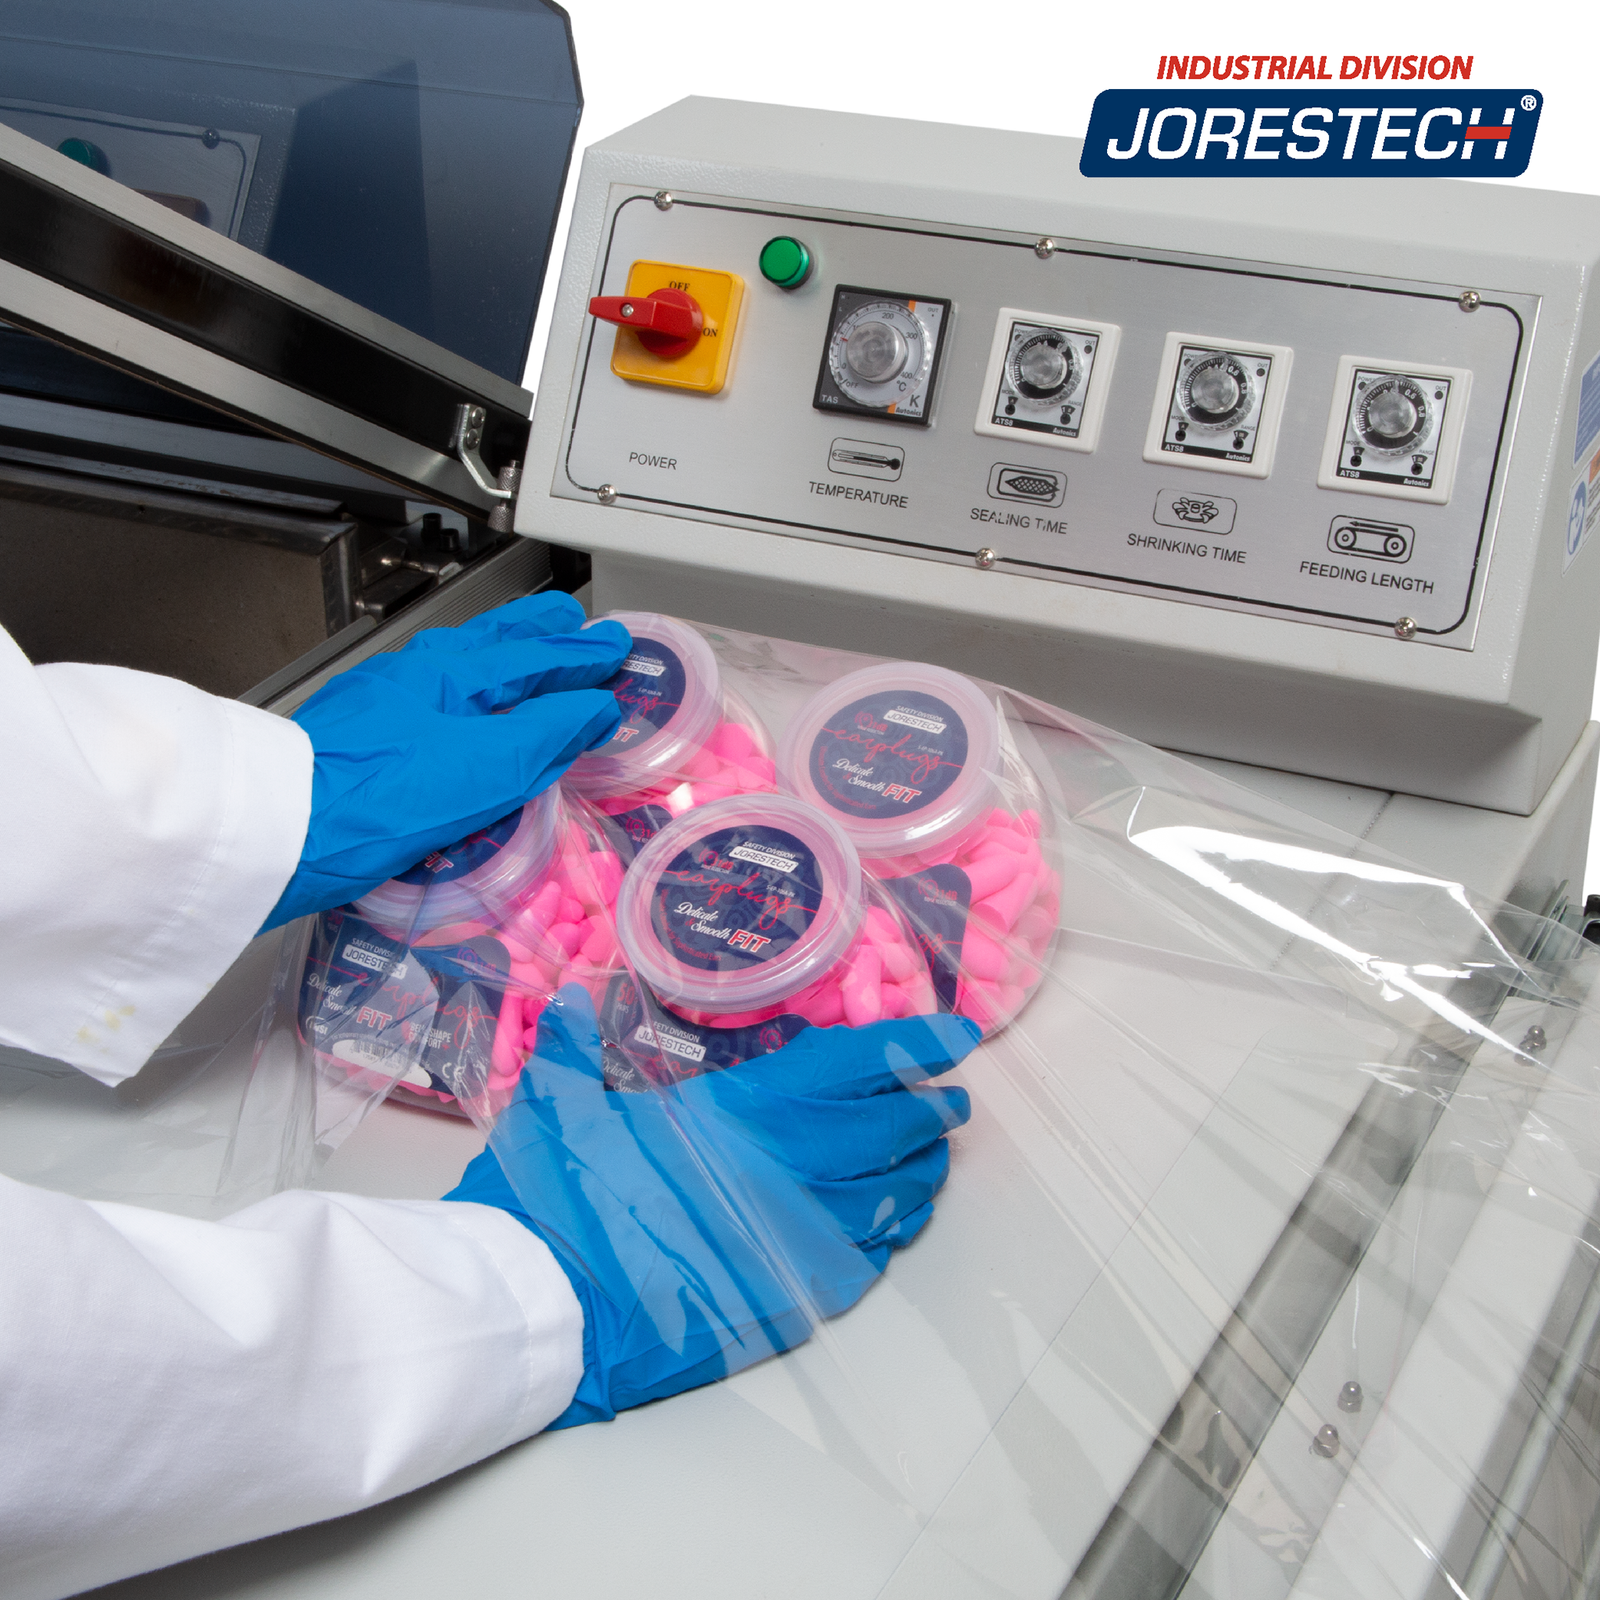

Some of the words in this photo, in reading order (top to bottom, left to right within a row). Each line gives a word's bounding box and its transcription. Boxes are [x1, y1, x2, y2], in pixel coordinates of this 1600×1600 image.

[669, 280, 691, 291] OFF
[881, 312, 895, 320] 200
[703, 327, 718, 337] ON
[905, 331, 919, 340] 300
[900, 371, 913, 380] 400
[821, 394, 839, 404] TAS
[909, 394, 921, 408] K
[1404, 389, 1416, 400] 0.6
[895, 406, 922, 417] Autonics
[1417, 405, 1426, 418] 0.8
[1052, 427, 1077, 437] Autonics
[629, 452, 677, 470] POWER
[1225, 452, 1251, 462] Autonics
[1340, 469, 1360, 478] ATS8
[1403, 477, 1430, 487] Autonics
[809, 481, 909, 509] TEMPERATURE
[970, 508, 1030, 529] SEALING
[1034, 518, 1068, 535] TIME
[1127, 533, 1208, 558] SHRINKING
[1211, 546, 1247, 564] TIME
[1299, 561, 1367, 583] FEEDING
[1371, 572, 1435, 595] LENGTH
[624, 660, 662, 674] RESTECH
[639, 655, 664, 666] DIVISION
[886, 711, 943, 733] JORESTECH
[896, 705, 917, 716] SAFETY
[916, 709, 945, 723] DIVISION
[614, 727, 638, 743] IT
[832, 758, 874, 777] Delicate
[834, 734, 941, 784] earplugs
[848, 774, 885, 792] Smooth
[882, 783, 922, 804] FIT
[742, 841, 766, 852] SAFETY
[765, 846, 795, 860] DIVISION
[734, 848, 795, 871] JORESTECH
[677, 871, 792, 931] earplugs
[674, 901, 719, 921] Delicate
[352, 938, 374, 951] SAFETY
[691, 919, 732, 940] Smooth
[727, 929, 771, 953] FIT
[617, 983, 635, 1006] 50
[356, 1006, 393, 1030] FIT
[429, 1028, 452, 1043] SHAPE
[654, 1022, 671, 1036] FETY
[669, 1026, 700, 1043] DIVISION
[638, 1028, 702, 1058] JORESTECH
